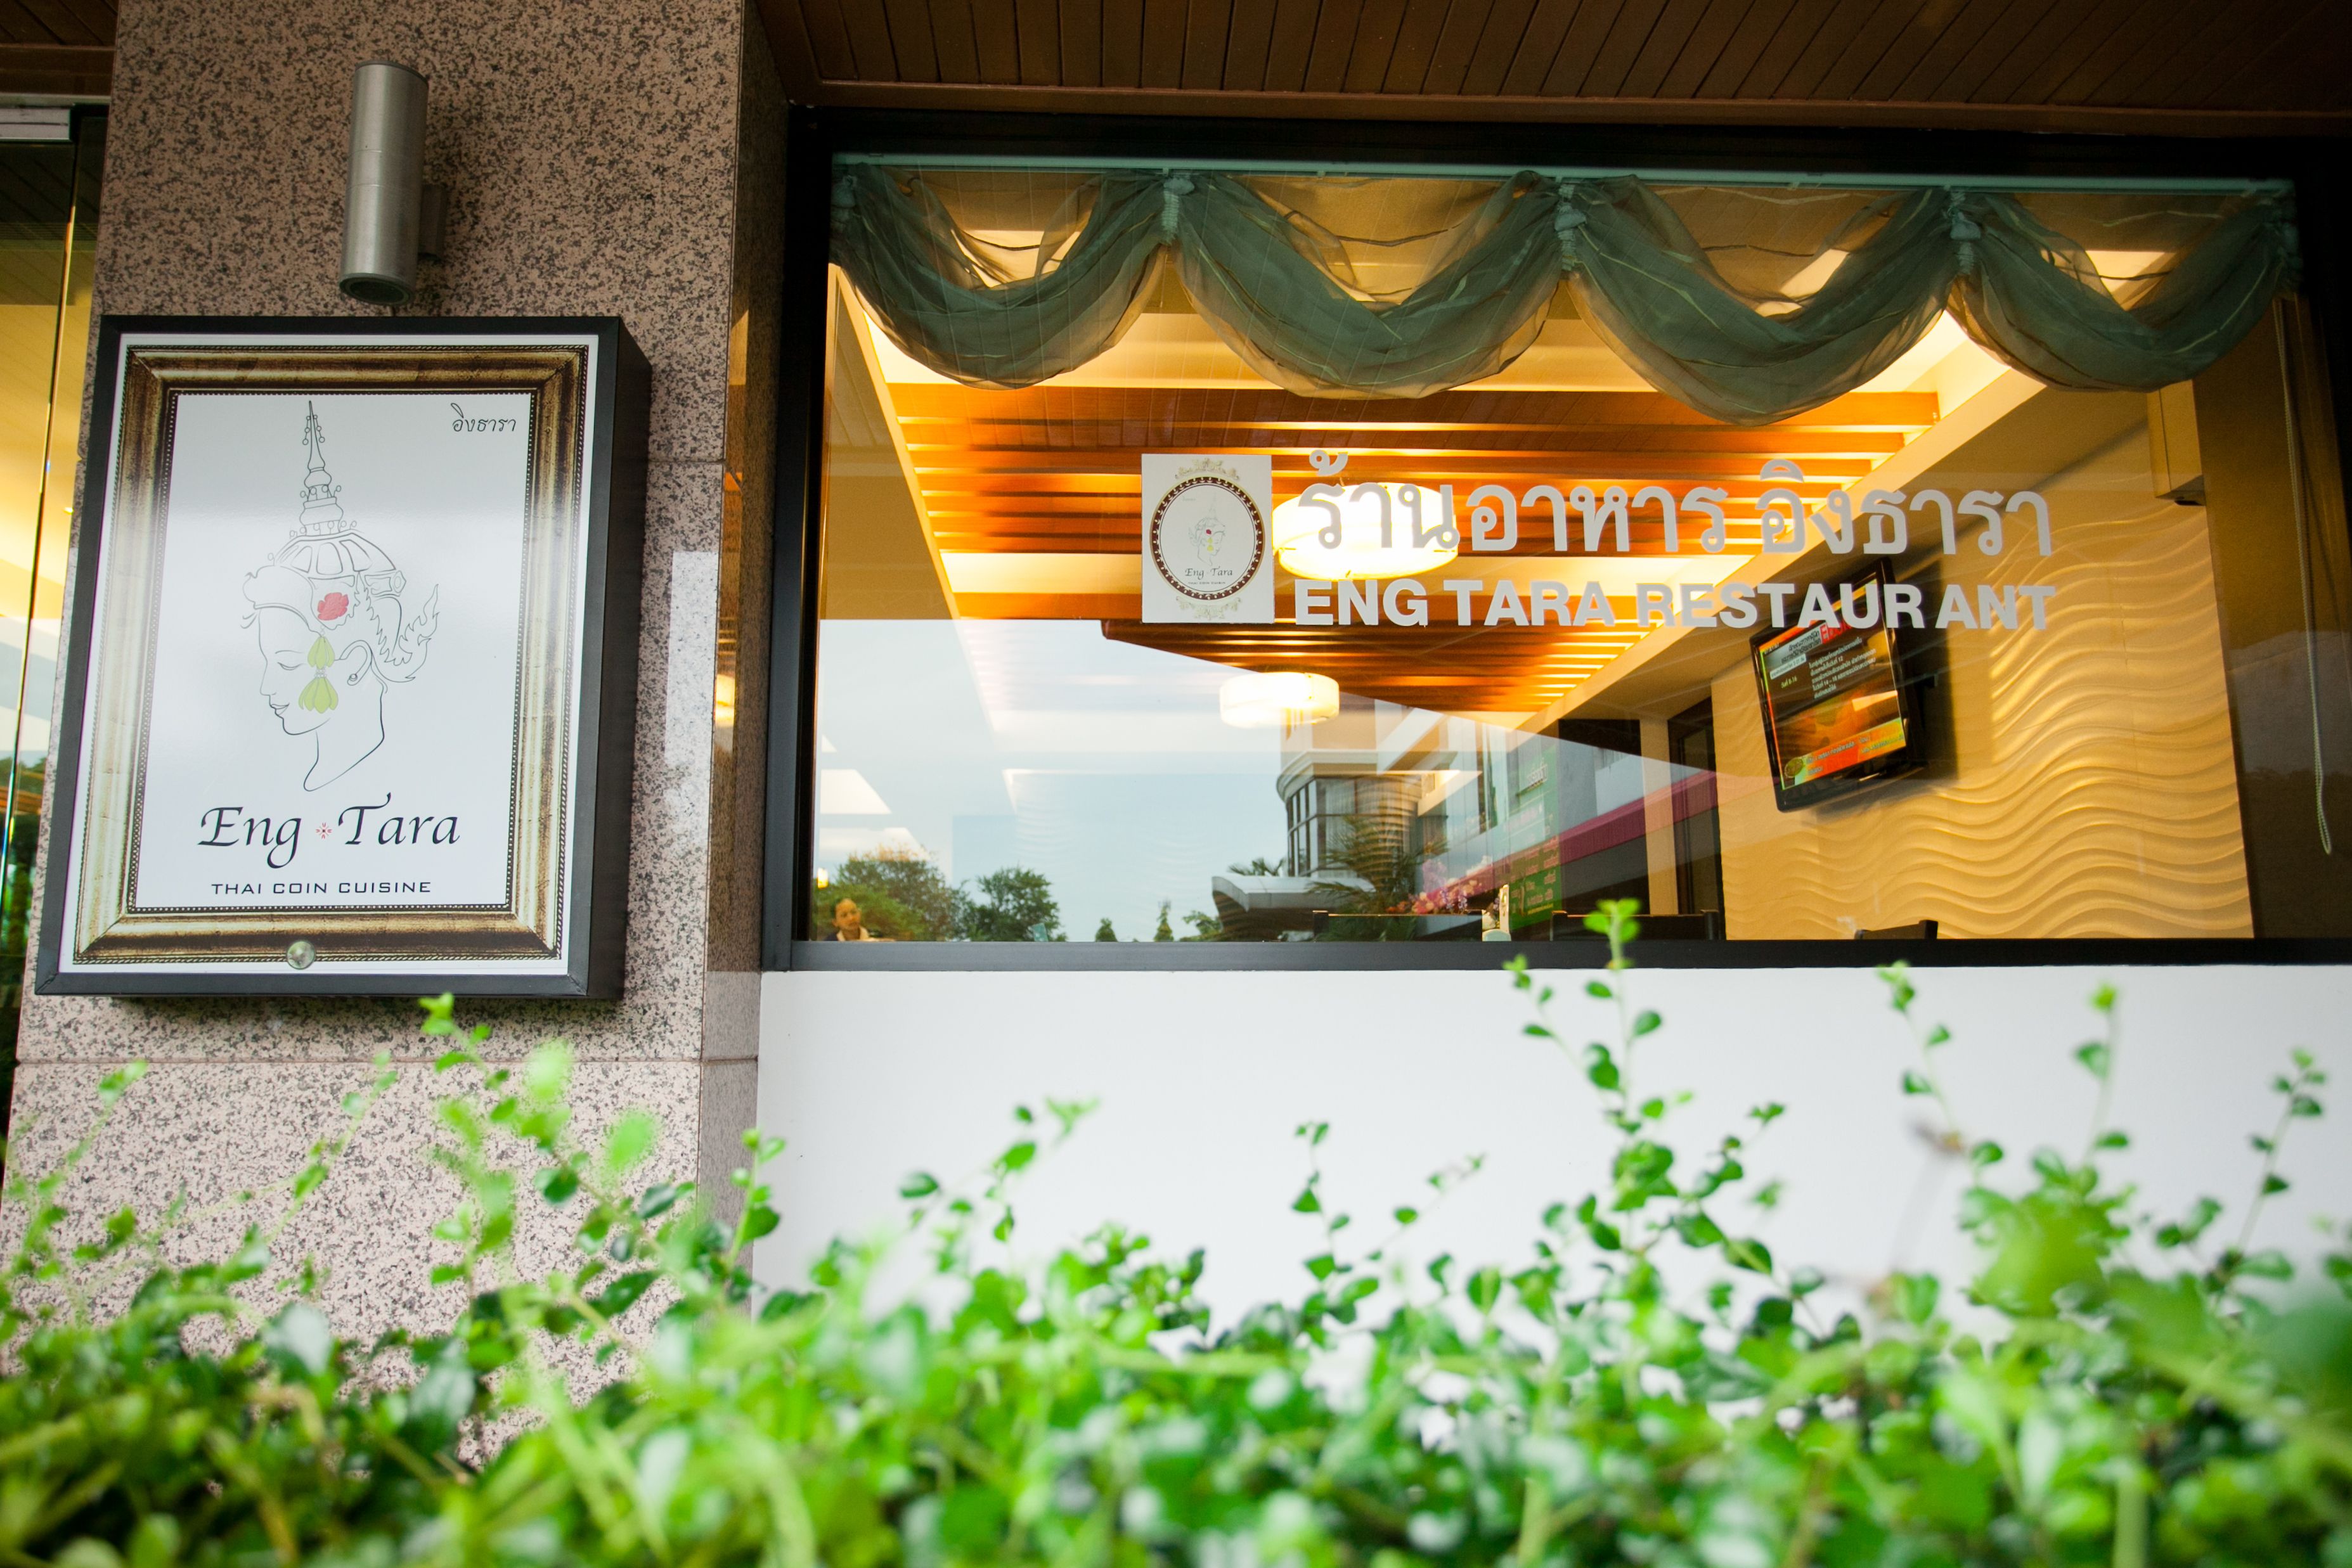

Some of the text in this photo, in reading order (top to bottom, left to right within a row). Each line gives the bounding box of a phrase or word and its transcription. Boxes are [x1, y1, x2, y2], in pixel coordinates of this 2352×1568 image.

[451, 402, 516, 432] อิงธารา
[1298, 449, 2052, 556] ร้านอาหาร อิงธารา
[1184, 565, 1233, 581] Eng Tara
[1295, 578, 2056, 630] ENG TARA RESTAURANT
[197, 792, 460, 869] Eng Tara
[211, 882, 431, 895] THAI COIN CUISINE
